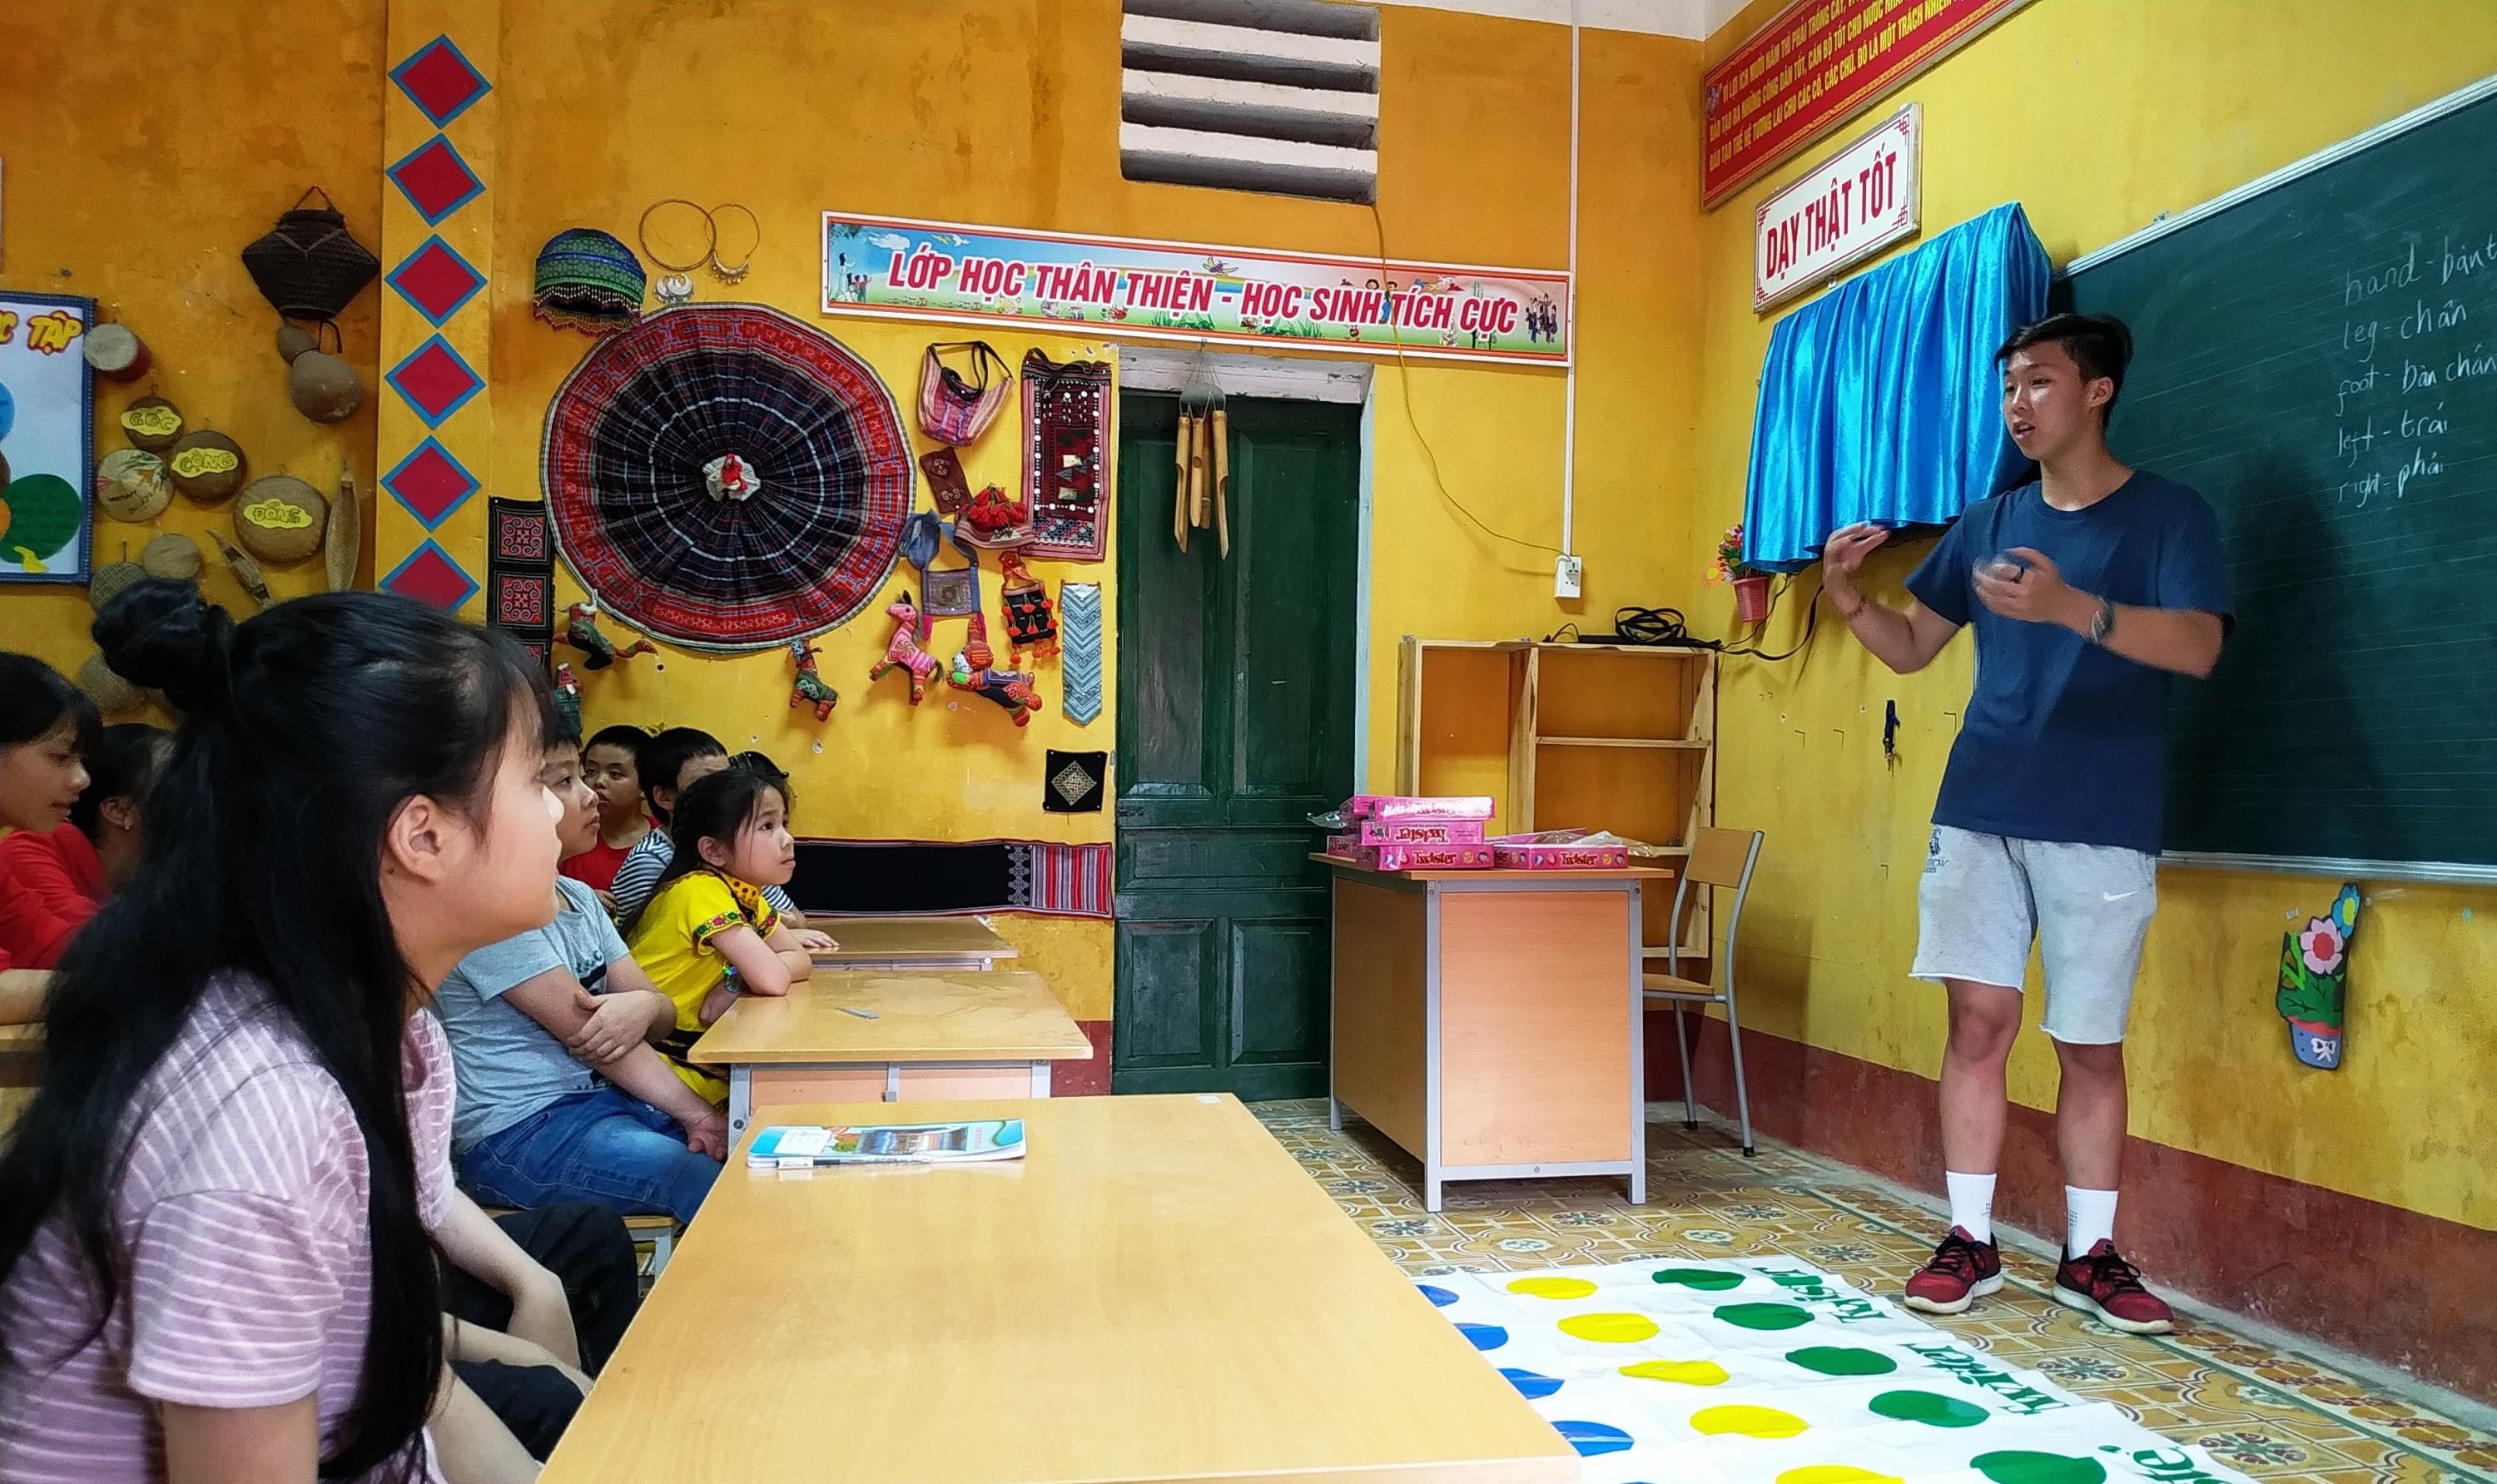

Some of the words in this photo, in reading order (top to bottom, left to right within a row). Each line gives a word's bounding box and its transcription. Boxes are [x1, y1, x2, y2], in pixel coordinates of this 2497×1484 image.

[1765, 211, 1800, 281] DẠY
[1804, 176, 1853, 253] THẬT
[1859, 141, 1897, 226] TỐT
[888, 244, 952, 290] LỚP
[959, 258, 1025, 302] HỌC
[1035, 261, 1118, 305] THÂN
[1126, 270, 1214, 318] THIỆN
[1240, 283, 1302, 325] HỌC
[1309, 286, 1383, 325] SINH
[1391, 287, 1454, 330] TÍCH
[1459, 296, 1518, 340] CỰC
[2345, 241, 2422, 307] hand
[27, 309, 85, 356] TẬP
[2344, 320, 2378, 363] leg
[2400, 298, 2467, 340] chân
[2335, 363, 2380, 417] foot
[2337, 414, 2375, 469] left
[2400, 401, 2448, 439] trái
[2337, 470, 2380, 509] right
[1395, 827, 1449, 843] Twister
[1412, 851, 1457, 866] Twister
[1560, 852, 1598, 866] Twister
